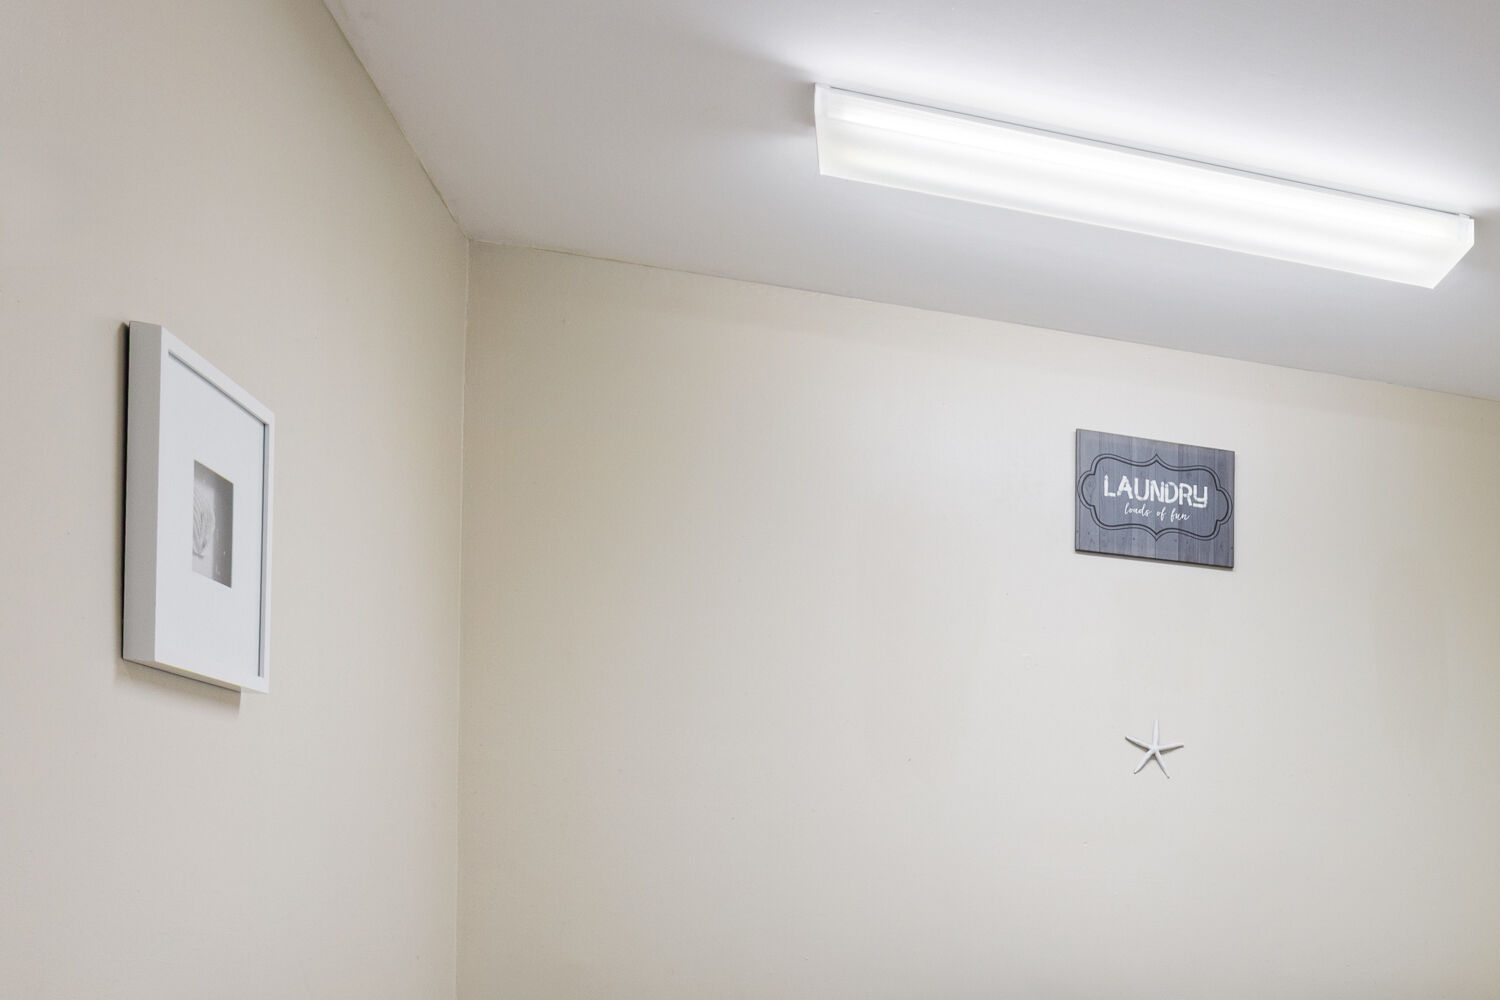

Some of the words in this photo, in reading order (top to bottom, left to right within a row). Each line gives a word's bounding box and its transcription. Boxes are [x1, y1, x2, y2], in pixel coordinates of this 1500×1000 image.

[1103, 474, 1208, 509] LAUNDRY
[1124, 502, 1151, 517] loads
[1156, 507, 1167, 521] of
[1170, 508, 1192, 522] fun
